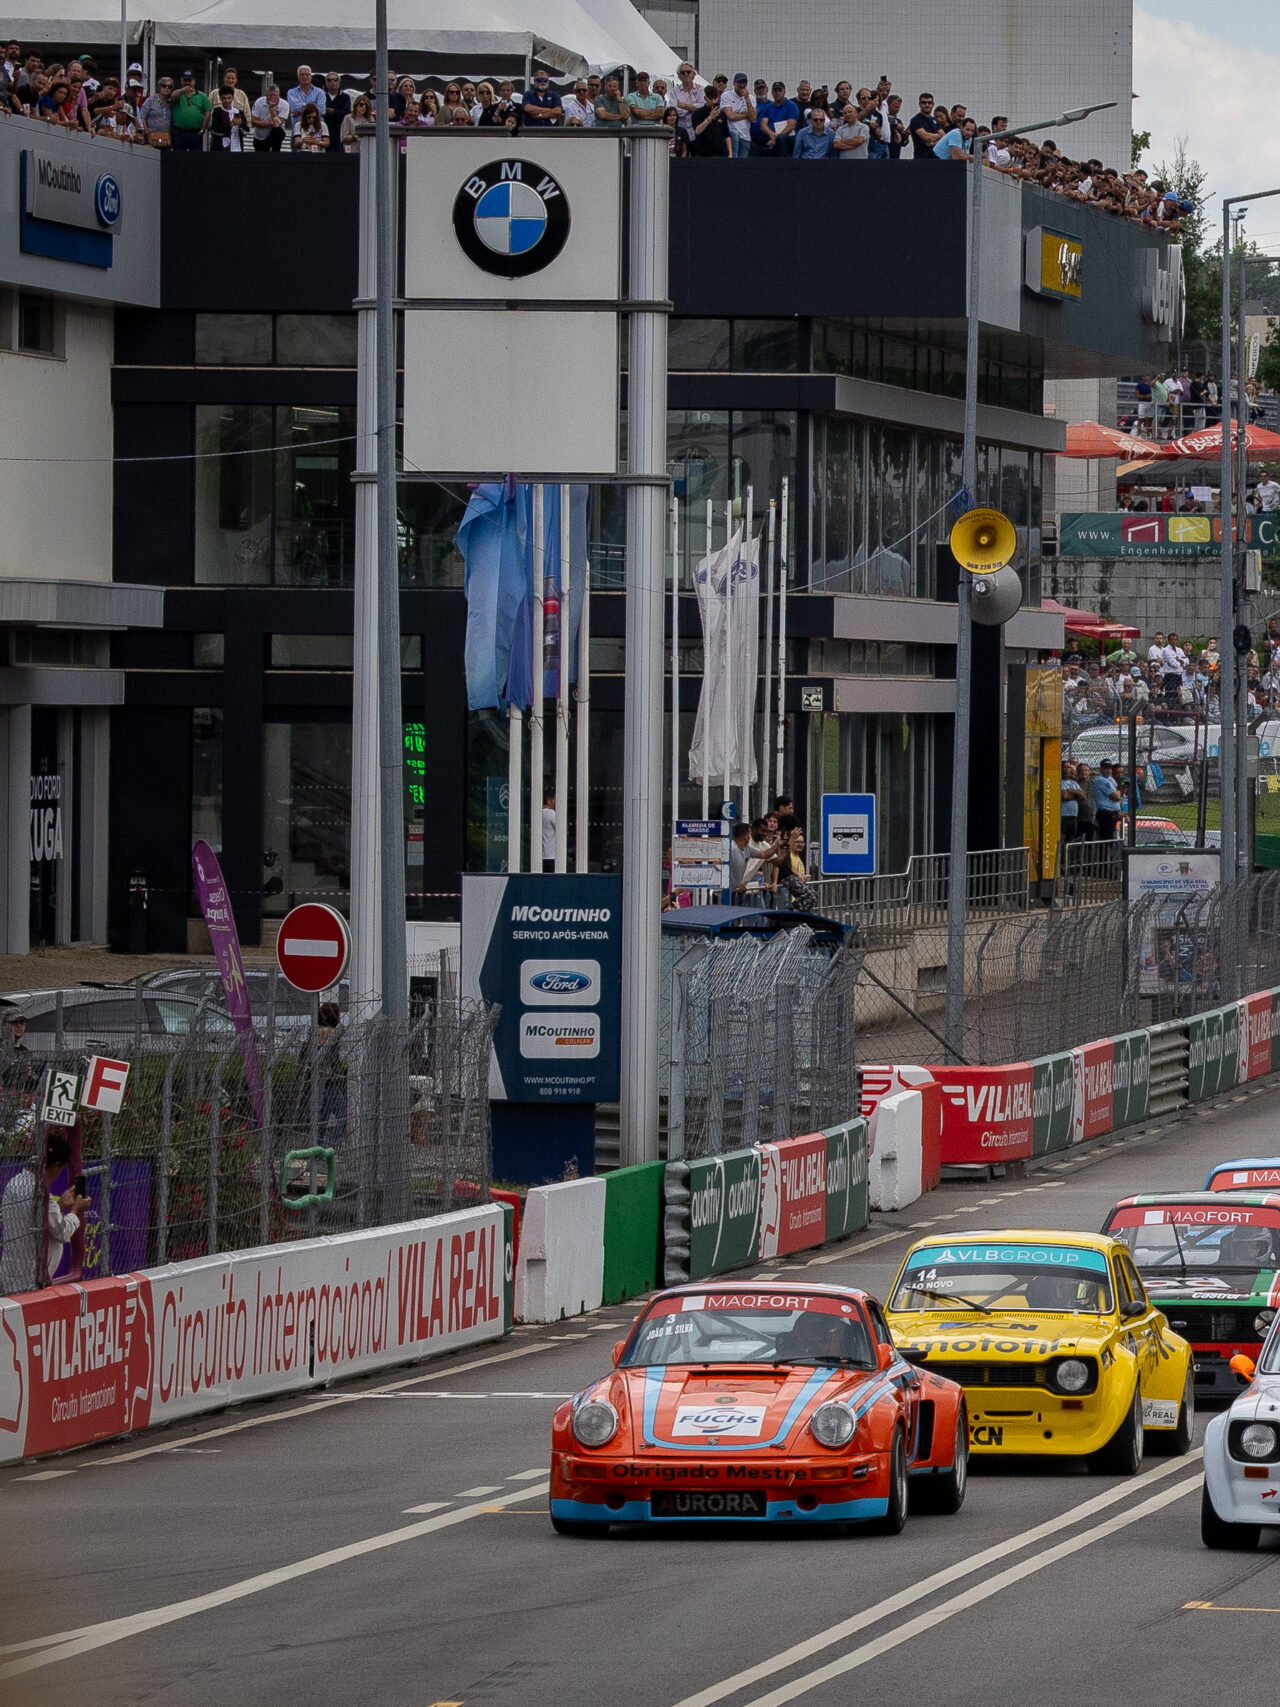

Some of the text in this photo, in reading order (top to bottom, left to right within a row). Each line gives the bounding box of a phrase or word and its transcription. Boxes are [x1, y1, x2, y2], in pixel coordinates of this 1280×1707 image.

[38, 158, 82, 194] MCoutinho
[464, 162, 560, 200] BMW
[103, 182, 119, 214] Ford
[1077, 529, 1115, 541] www.
[1120, 545, 1192, 555] Engenharia
[513, 929, 609, 941] SERVIÇO APÓS-VENDA
[542, 973, 579, 990] Ford
[87, 1057, 129, 1107] F
[967, 1082, 1032, 1121] VILA REAL
[46, 1108, 73, 1124] EXIT
[786, 1151, 825, 1202] VILA REAL
[1166, 1211, 1253, 1223] MAQFORT
[958, 1249, 1079, 1264] VLBGROUP
[917, 1268, 937, 1282] 14
[926, 1280, 954, 1289] NOVO
[708, 1296, 814, 1310] MAQFORT
[159, 1224, 499, 1404] Circuito Internacional VILA REAL
[666, 1313, 676, 1324] 3
[647, 1323, 694, 1340] JOÃO M. SILVA
[41, 1304, 124, 1383] VILA REAL
[51, 1380, 116, 1423] Circuito Internacional
[679, 1413, 761, 1425] FUCHS
[1152, 1411, 1176, 1419] REAL
[612, 1464, 807, 1480] Obrigado Mestre
[658, 1492, 759, 1513] AURORA
